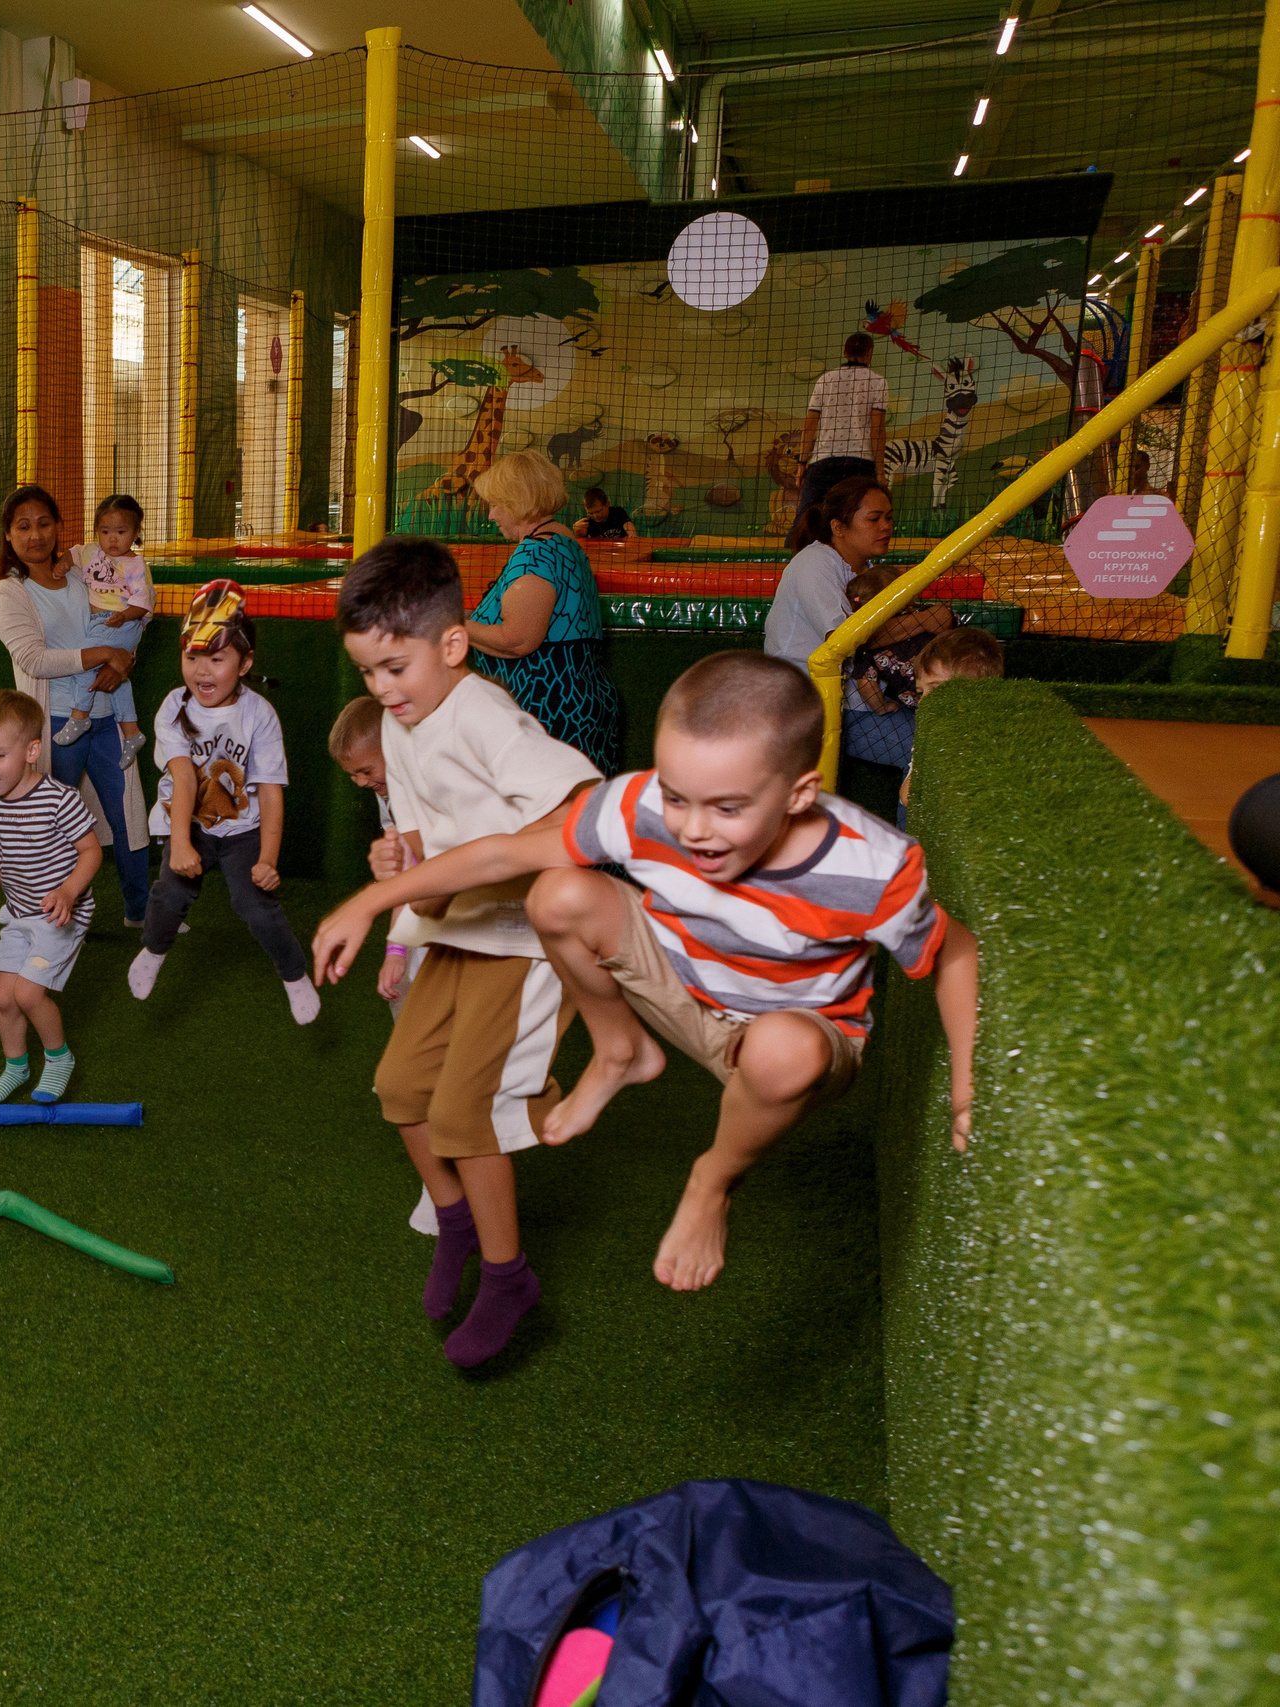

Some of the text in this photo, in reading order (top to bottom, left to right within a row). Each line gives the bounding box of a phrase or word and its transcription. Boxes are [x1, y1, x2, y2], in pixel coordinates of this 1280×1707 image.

[1088, 551, 1168, 561] ОСТОРОЖНО,
[1104, 563, 1149, 571] КРУТАЯ
[1092, 574, 1158, 585] ЛЕСТНИЦА
